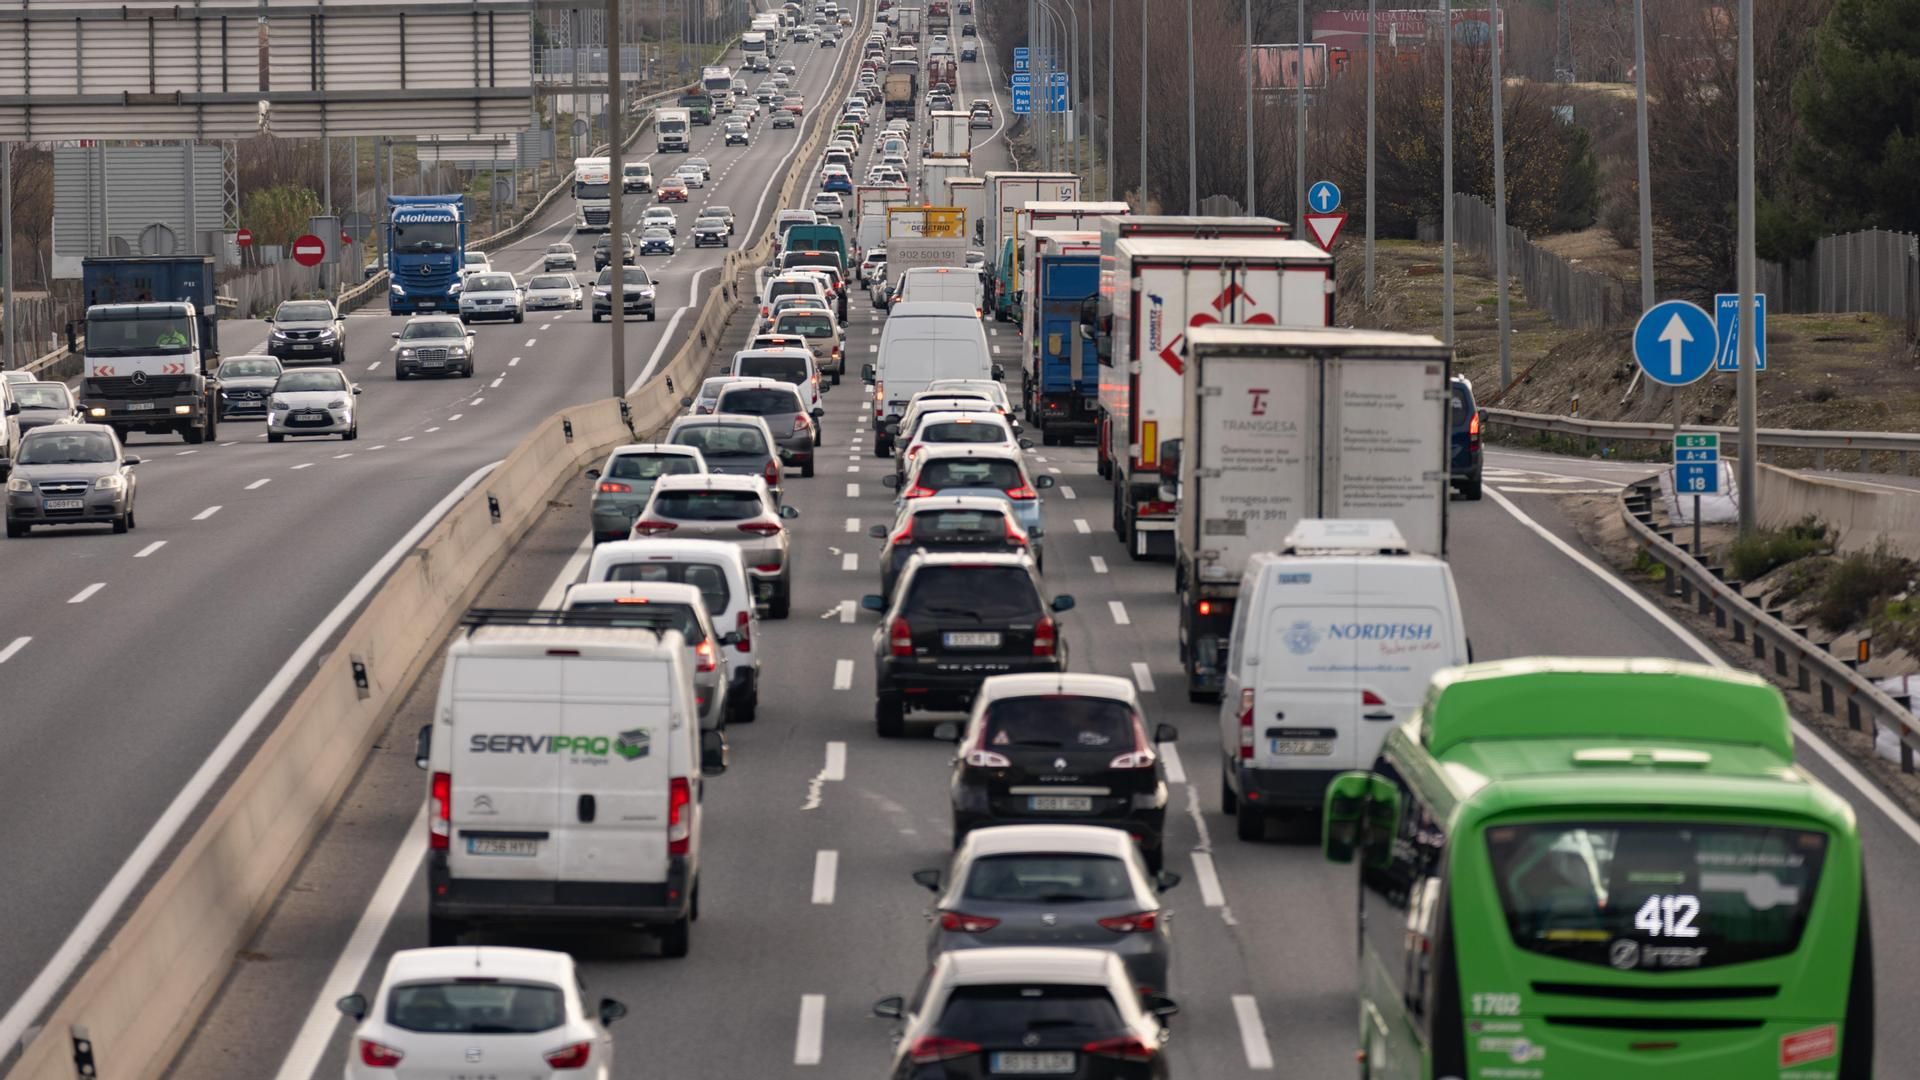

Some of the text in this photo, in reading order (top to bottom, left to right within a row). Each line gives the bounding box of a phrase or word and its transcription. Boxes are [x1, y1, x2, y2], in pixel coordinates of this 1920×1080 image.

[398, 213, 452, 224] Molinero
[911, 224, 951, 232] DEMETRIO
[899, 250, 919, 259] 902
[921, 250, 940, 259] 500
[1721, 300, 1761, 308] AUTA
[1222, 420, 1298, 432] TRANSGESA
[1686, 437, 1706, 446] E-5
[1686, 451, 1707, 460] A-4
[1689, 466, 1704, 475] km
[1688, 477, 1706, 491] 18
[1327, 623, 1433, 641] NORDFISH
[470, 734, 610, 755] SERVIPAQ
[1635, 894, 1700, 938] 412
